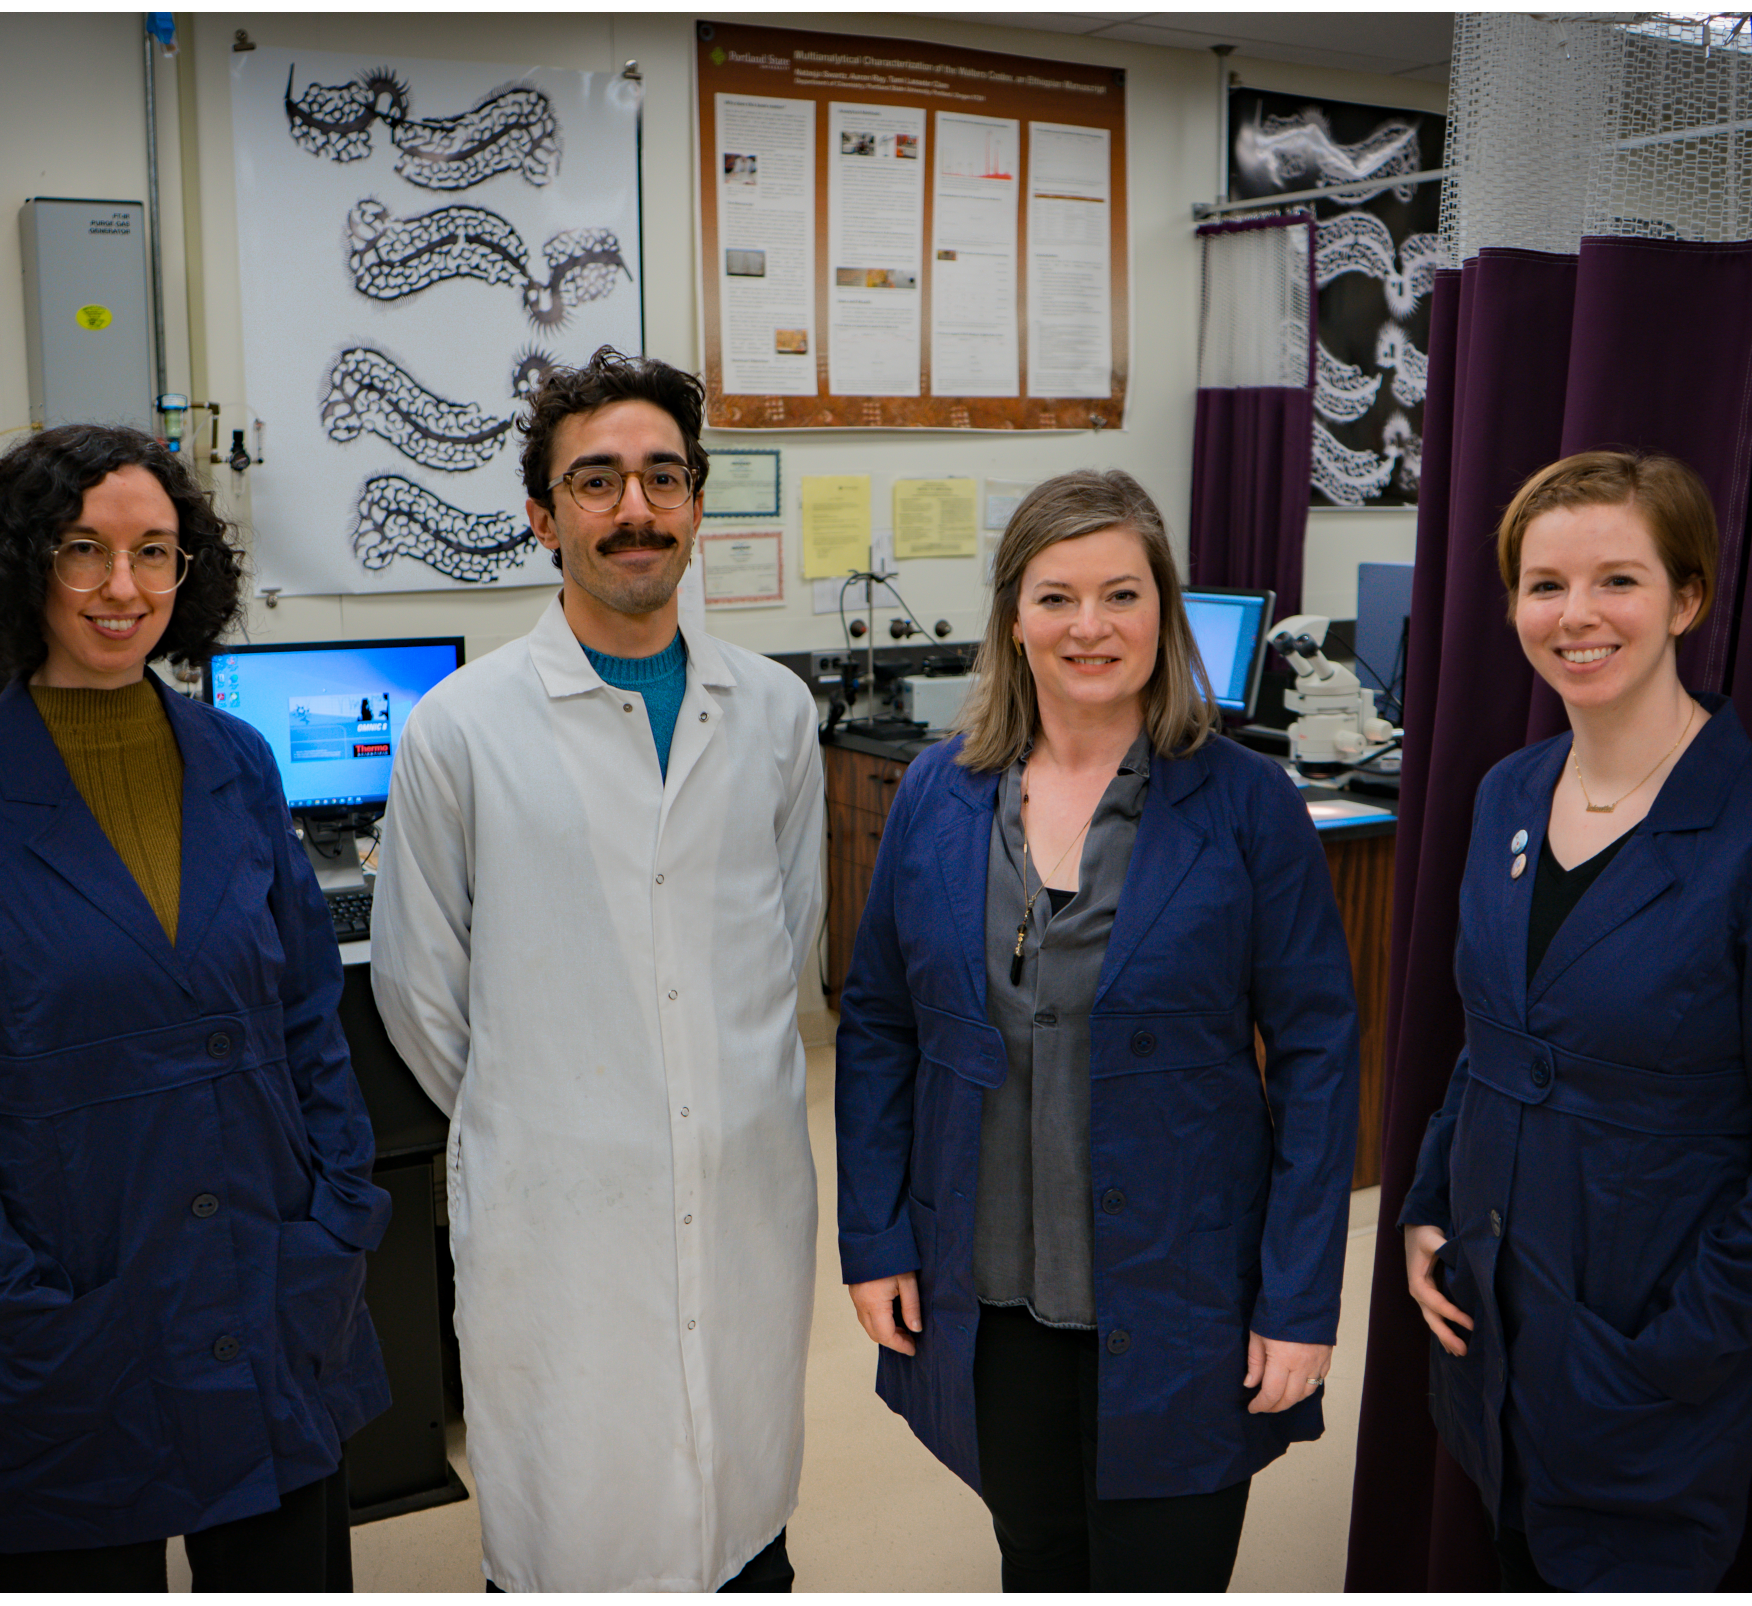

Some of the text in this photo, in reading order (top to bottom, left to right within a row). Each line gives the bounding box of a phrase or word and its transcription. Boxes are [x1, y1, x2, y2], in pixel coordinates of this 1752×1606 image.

[728, 50, 791, 66] Portland State
[793, 50, 861, 65] Multianalytical
[862, 55, 933, 71] Characterization
[945, 64, 957, 74] the
[1026, 75, 1062, 89] Ethiopian
[1062, 80, 1107, 94] Manuscript
[90, 219, 114, 227] PURGE
[357, 723, 381, 732] OMNIC
[355, 744, 388, 753] Thermo
